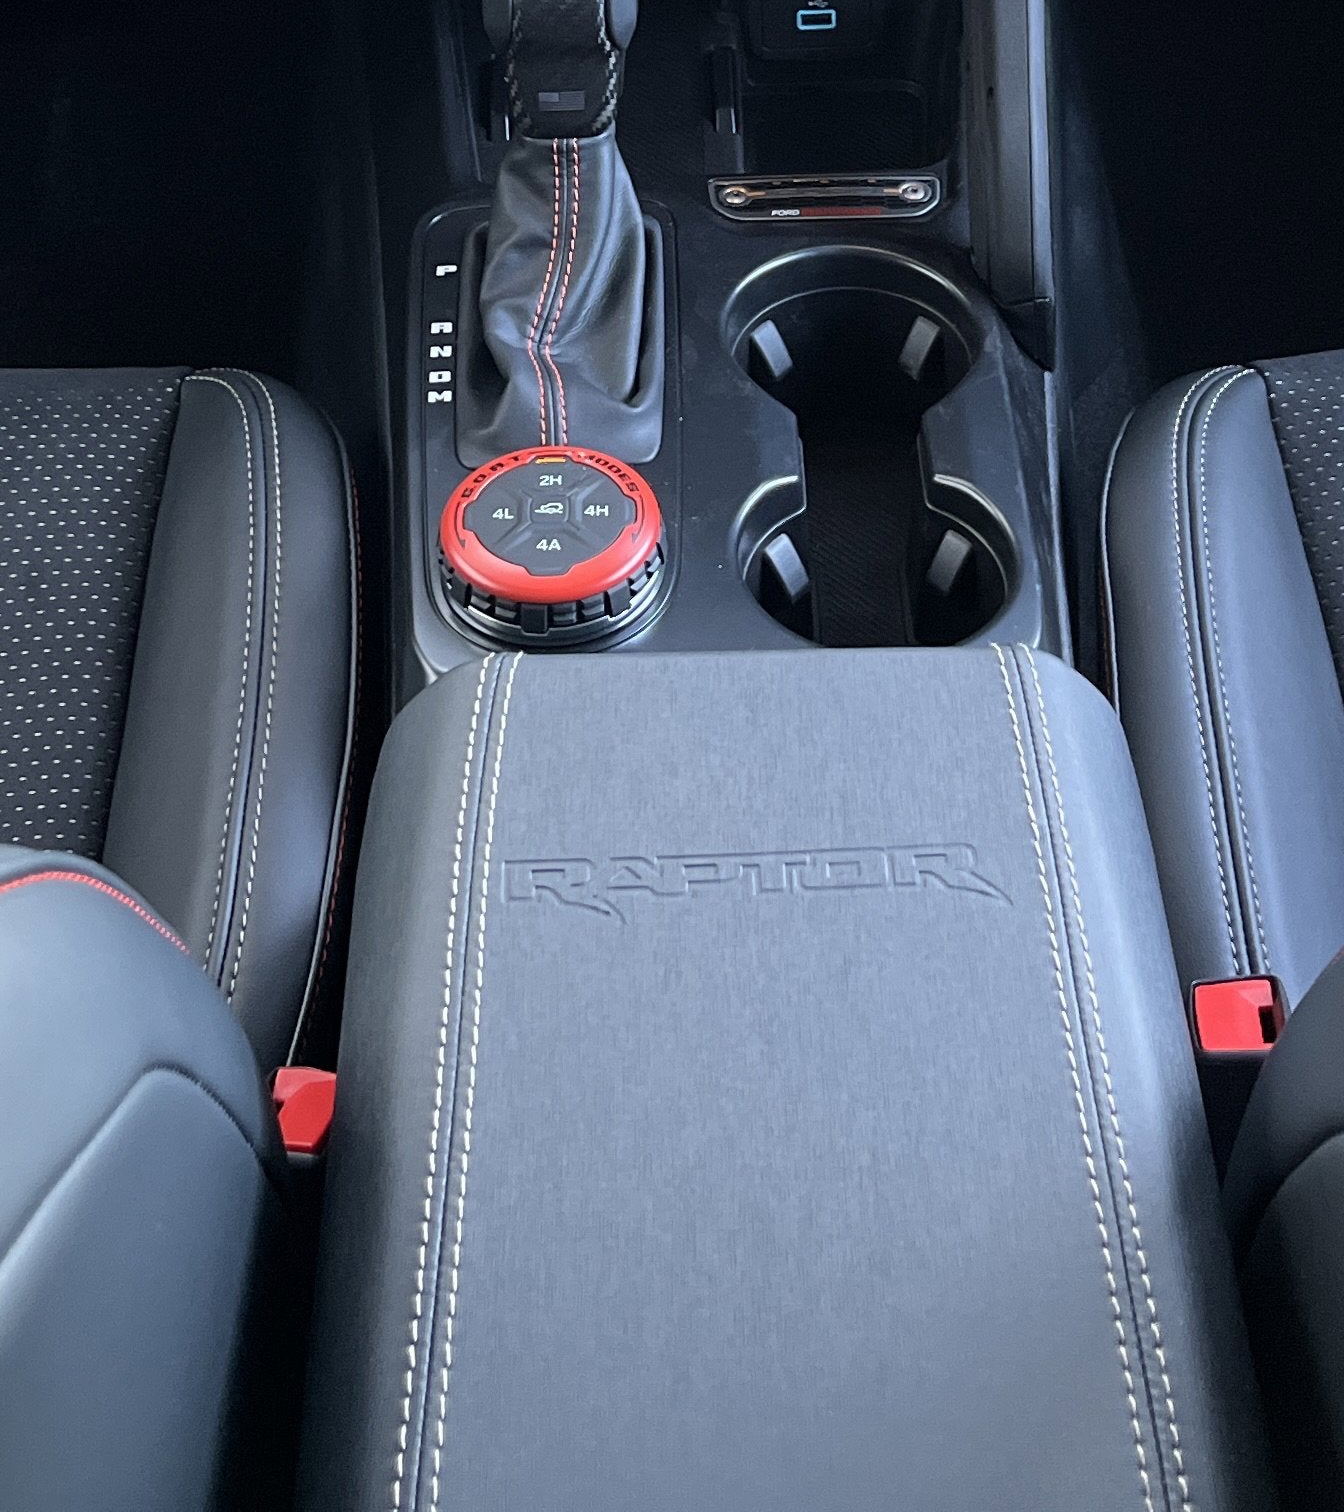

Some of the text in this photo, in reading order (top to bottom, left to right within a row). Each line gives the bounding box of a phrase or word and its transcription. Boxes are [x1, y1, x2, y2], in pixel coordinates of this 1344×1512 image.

[771, 209, 801, 217] FORD
[436, 265, 457, 276] P
[430, 345, 452, 358] N
[429, 370, 451, 383] D
[427, 391, 452, 403] M
[539, 474, 562, 486] 2H
[492, 508, 514, 520] 4L
[584, 505, 609, 517] 4H
[536, 538, 561, 551] 4A
[500, 842, 1014, 925] RAPTOR
